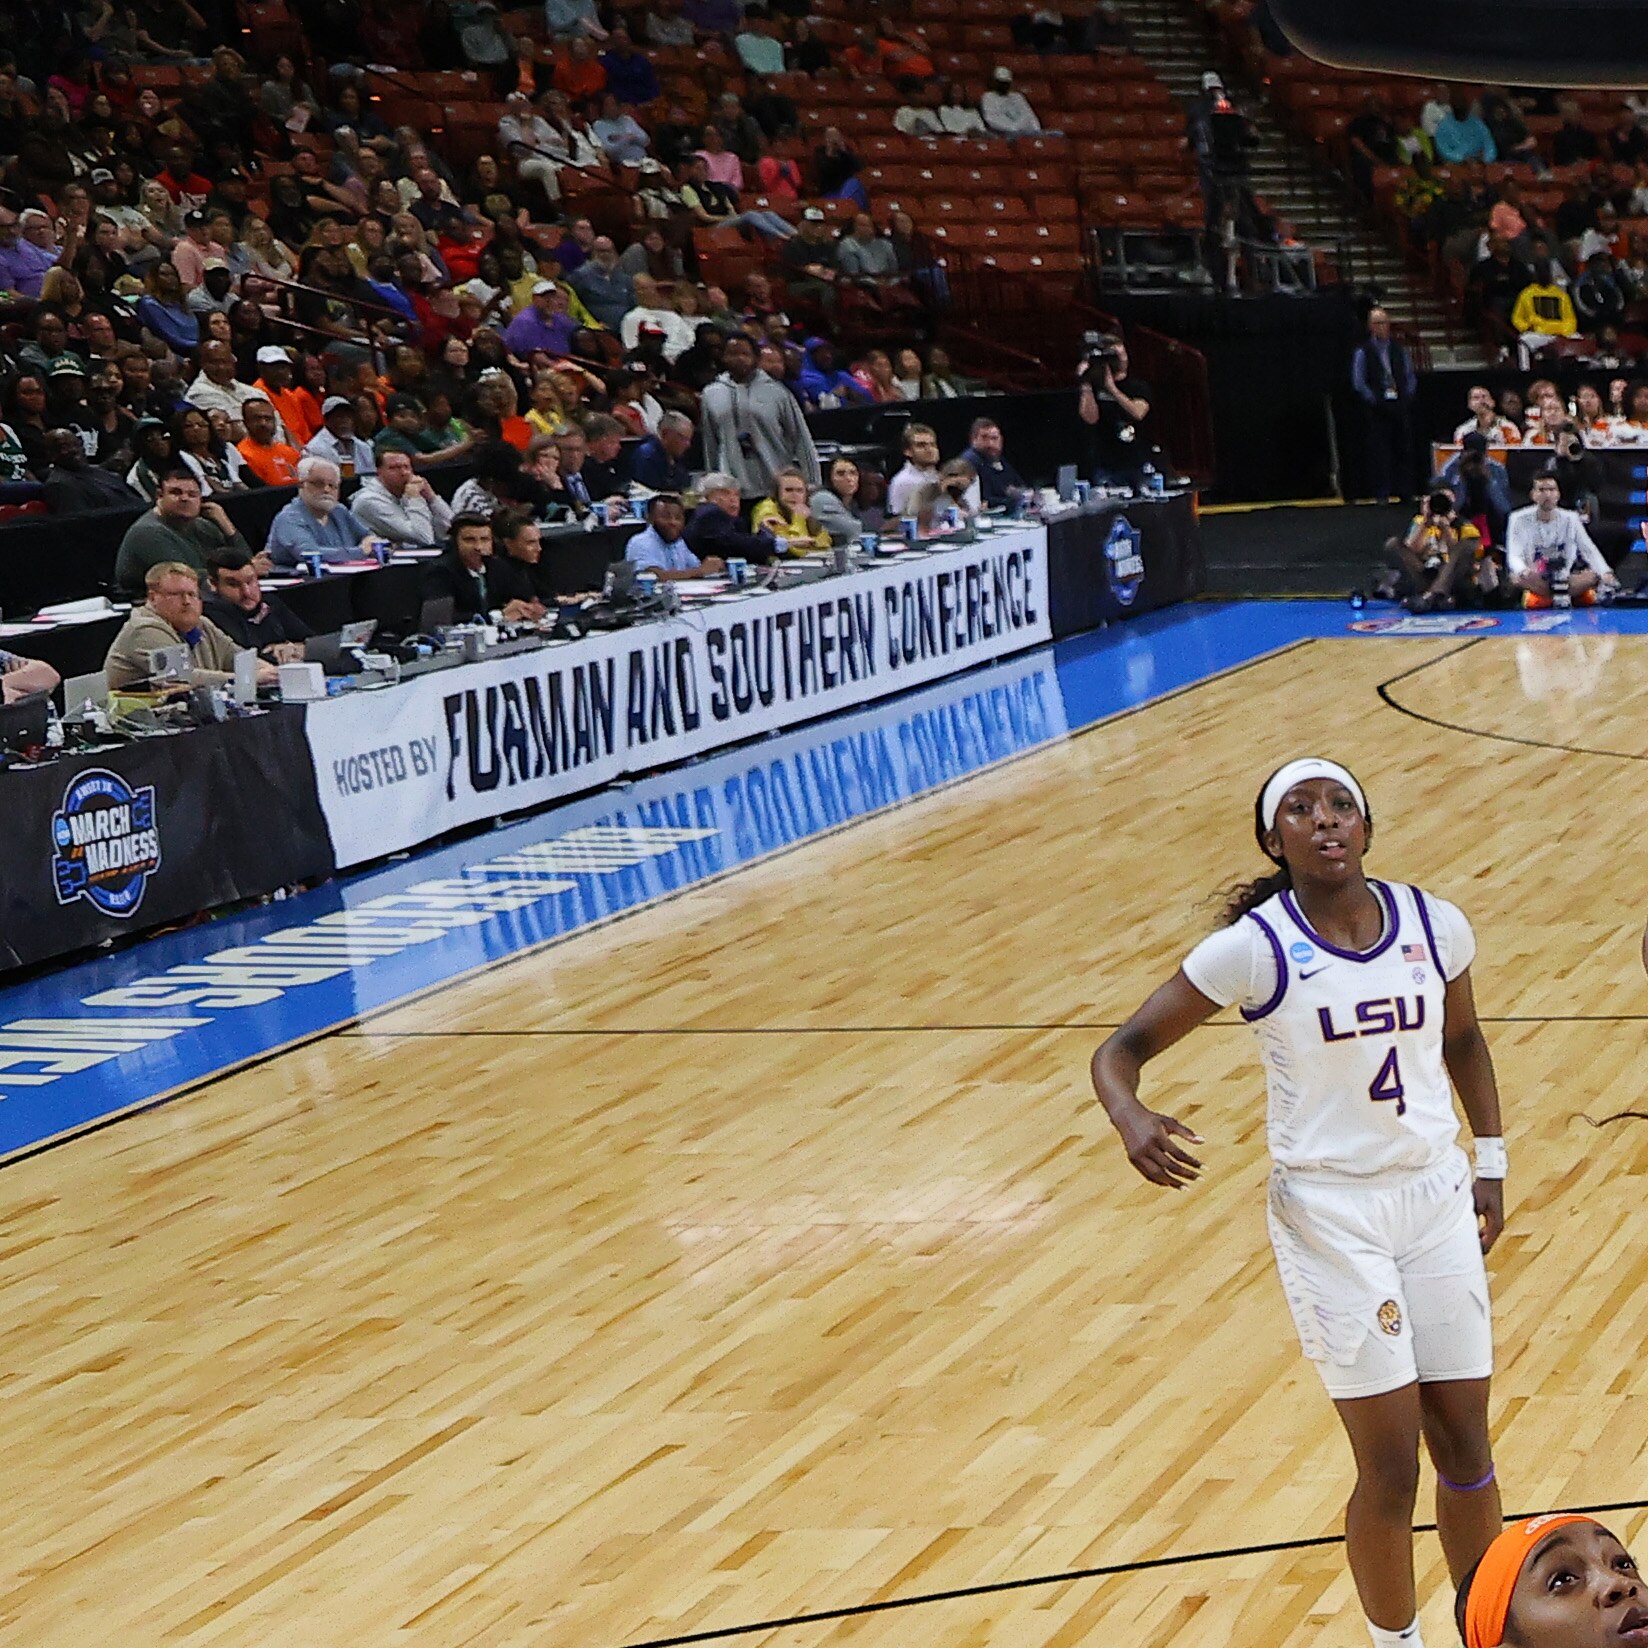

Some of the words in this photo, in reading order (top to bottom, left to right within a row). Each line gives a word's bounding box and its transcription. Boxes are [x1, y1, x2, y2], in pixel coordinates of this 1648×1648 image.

[332, 744, 406, 798] HOSTED
[409, 735, 438, 776] BY
[444, 656, 615, 801] FURMAN
[628, 636, 700, 749] AND
[706, 590, 877, 721] SOUTHERN
[885, 548, 1037, 670] CONFERENCE
[69, 804, 131, 846] MARCH
[85, 829, 158, 875] MADNESS
[1316, 995, 1425, 1043] LSU
[1369, 1046, 1406, 1117] 4
